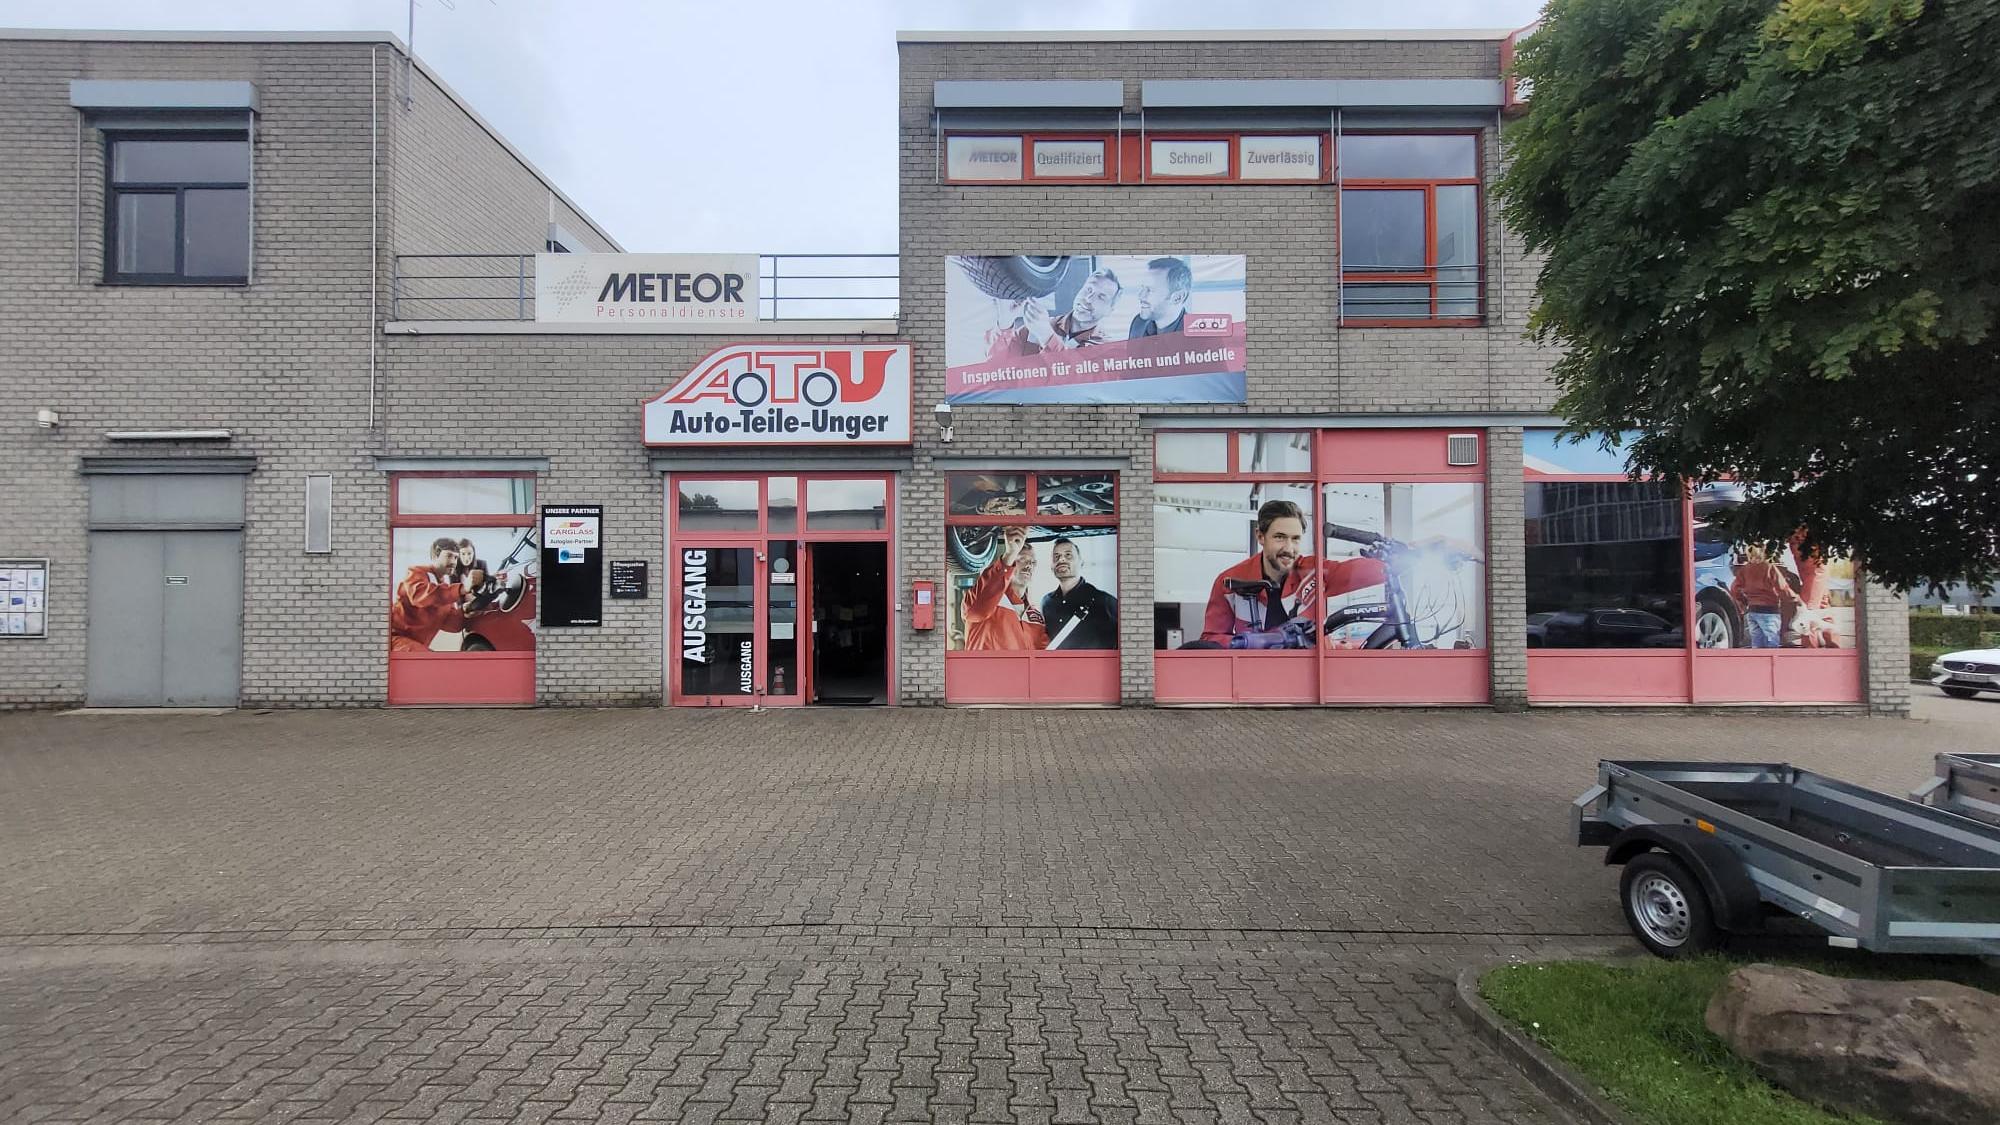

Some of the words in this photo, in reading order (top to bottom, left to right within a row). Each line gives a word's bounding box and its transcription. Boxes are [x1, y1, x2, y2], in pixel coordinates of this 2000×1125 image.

[969, 151, 1017, 163] METEOR
[1037, 151, 1102, 165] Qualifiziert
[1169, 152, 1212, 165] Schnell
[1247, 151, 1315, 166] Zuverlässig
[596, 305, 745, 318] Personaldienste
[962, 366, 1048, 385] Inspektionen
[1051, 362, 1071, 376] für
[1075, 360, 1100, 374] alle
[1103, 356, 1152, 371] Marken
[1156, 352, 1180, 367] und
[1184, 347, 1235, 364] Modelle
[669, 408, 889, 440] Auto-Teile-Unger
[684, 550, 707, 663] AUSGANG
[741, 641, 752, 693] AUSGANG
